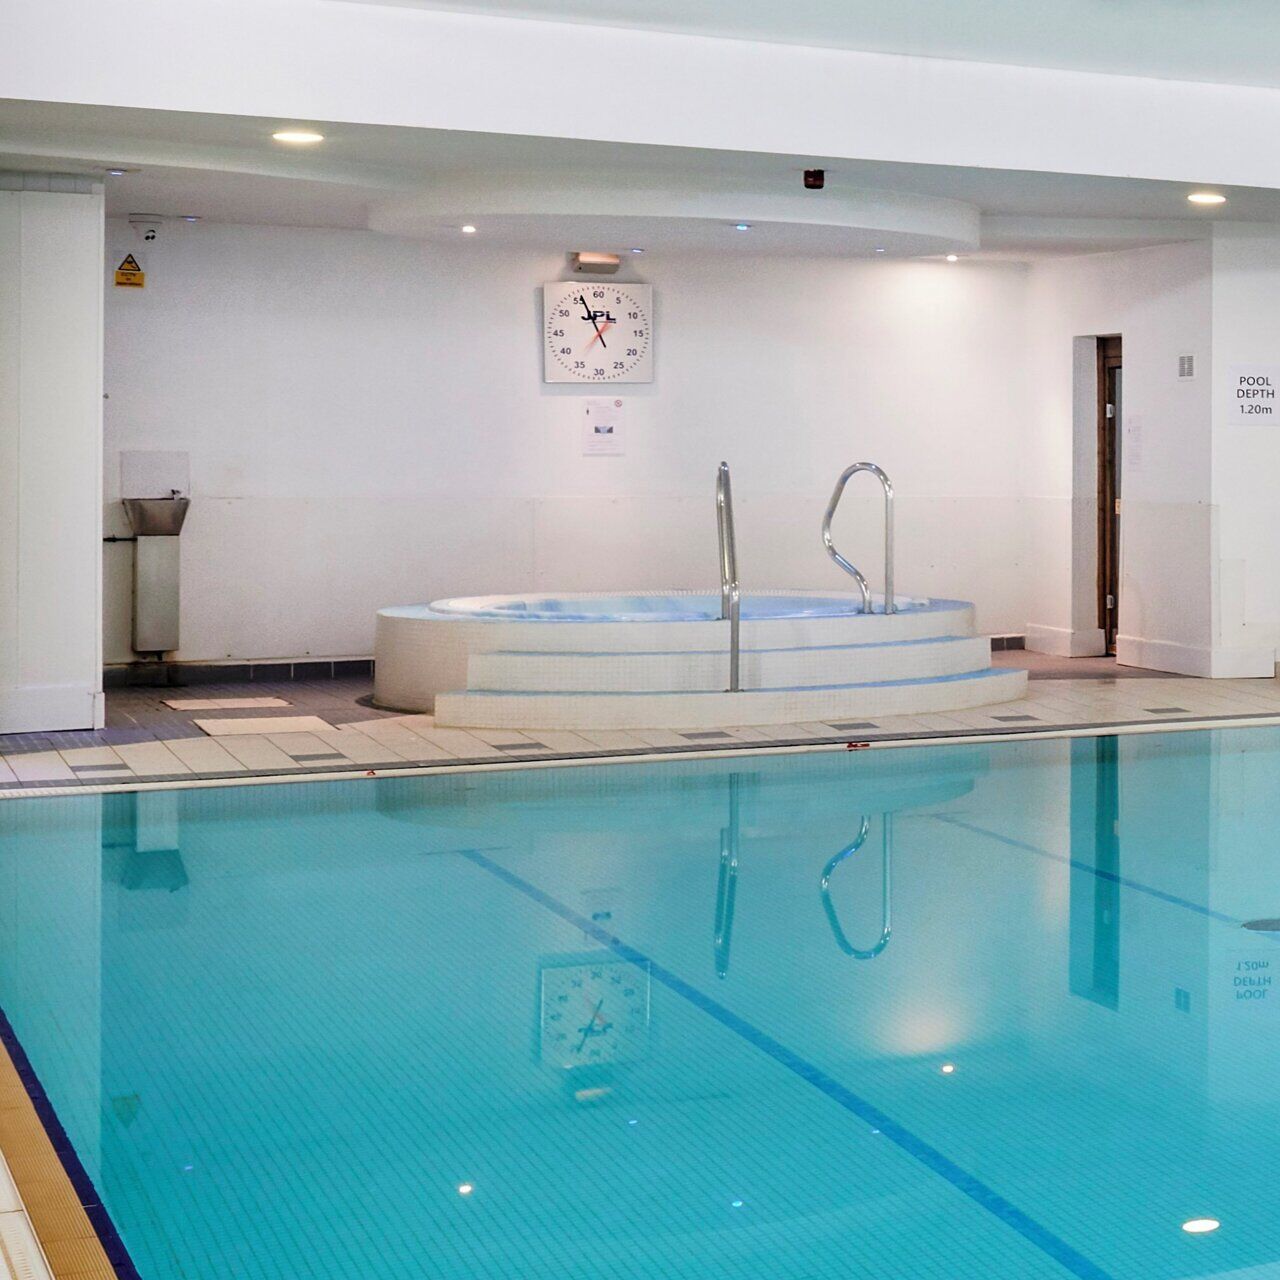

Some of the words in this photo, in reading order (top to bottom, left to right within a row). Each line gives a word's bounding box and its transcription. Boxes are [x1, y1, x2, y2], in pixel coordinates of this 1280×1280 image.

[581, 311, 616, 321] JPL
[560, 347, 571, 355] 40
[574, 361, 585, 369] 35
[594, 368, 604, 376] 30
[1239, 376, 1271, 386] POOL
[1236, 388, 1274, 399] DEPTH
[1240, 404, 1272, 414] 1.20m
